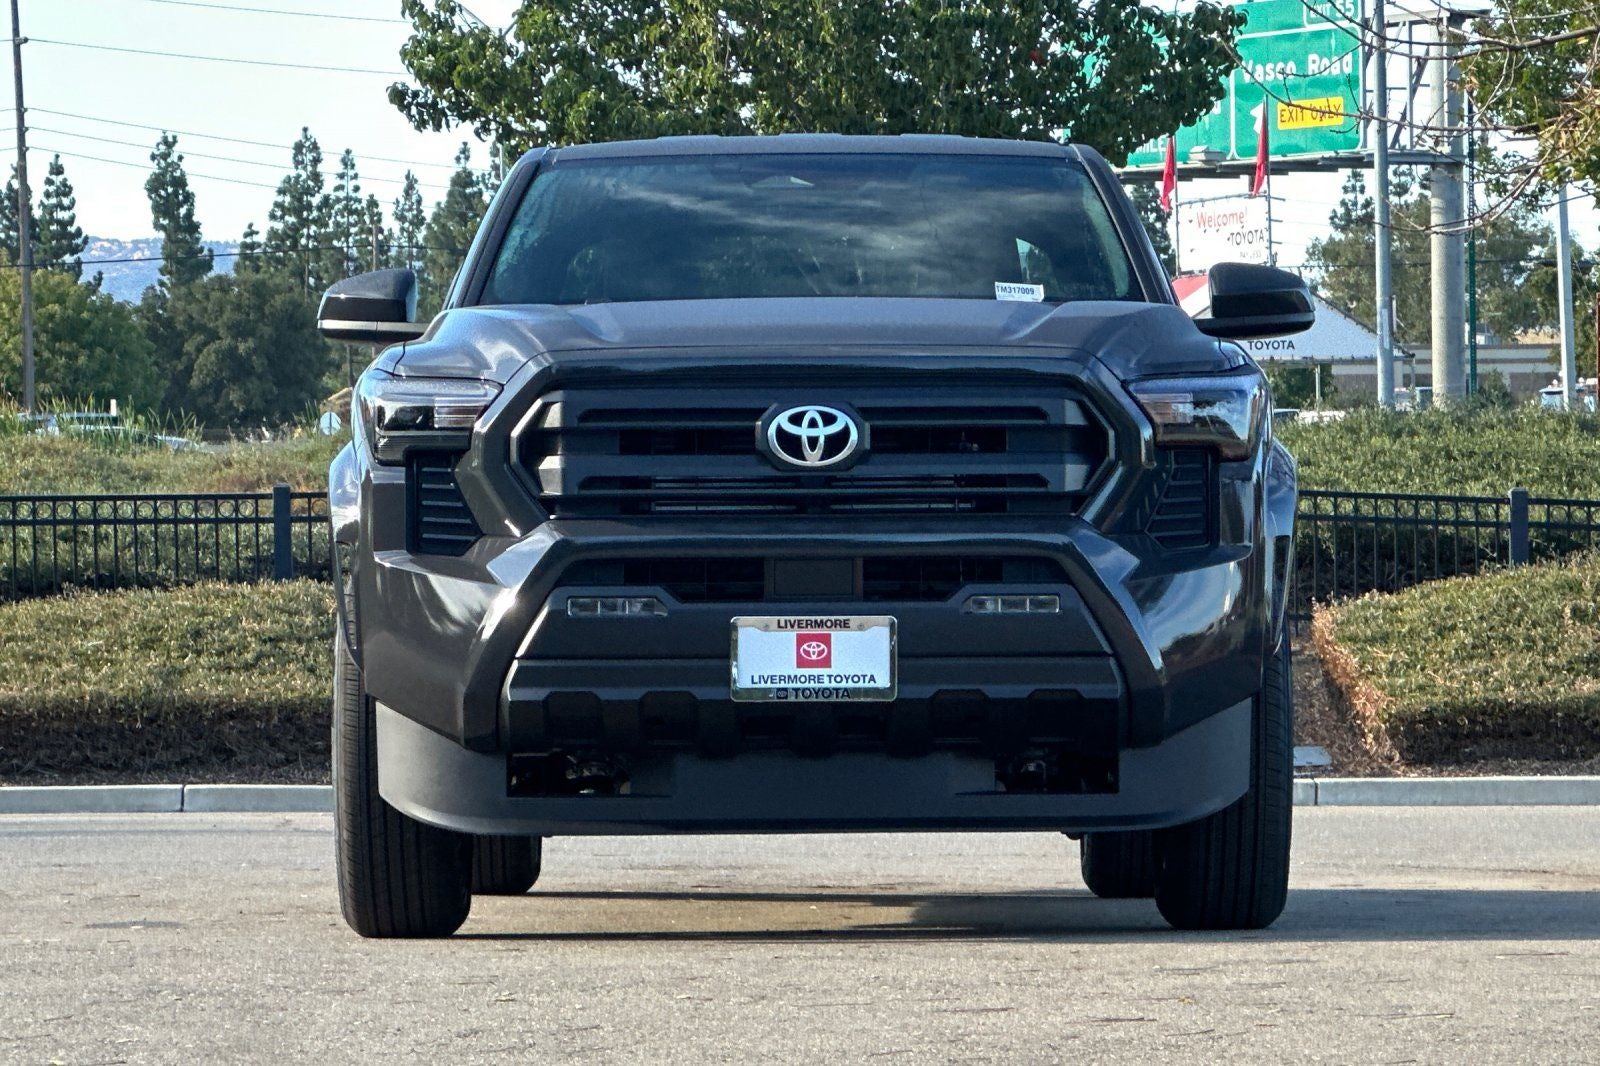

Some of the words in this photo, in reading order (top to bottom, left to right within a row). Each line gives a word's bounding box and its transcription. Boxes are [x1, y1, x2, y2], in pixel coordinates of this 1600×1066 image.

[1242, 60, 1297, 83] Vasco
[1307, 52, 1353, 76] Road
[1279, 107, 1304, 123] EXIT
[1310, 104, 1342, 121] ONLY
[1196, 206, 1248, 228] Welcome!
[1230, 229, 1265, 246] TOYOTA
[1248, 340, 1295, 350] TOYOTA
[777, 619, 851, 629] LIVERMORE
[751, 675, 825, 685] LIVERMORE
[827, 674, 877, 684] TOYOTA
[792, 688, 851, 699] TOYOTA
